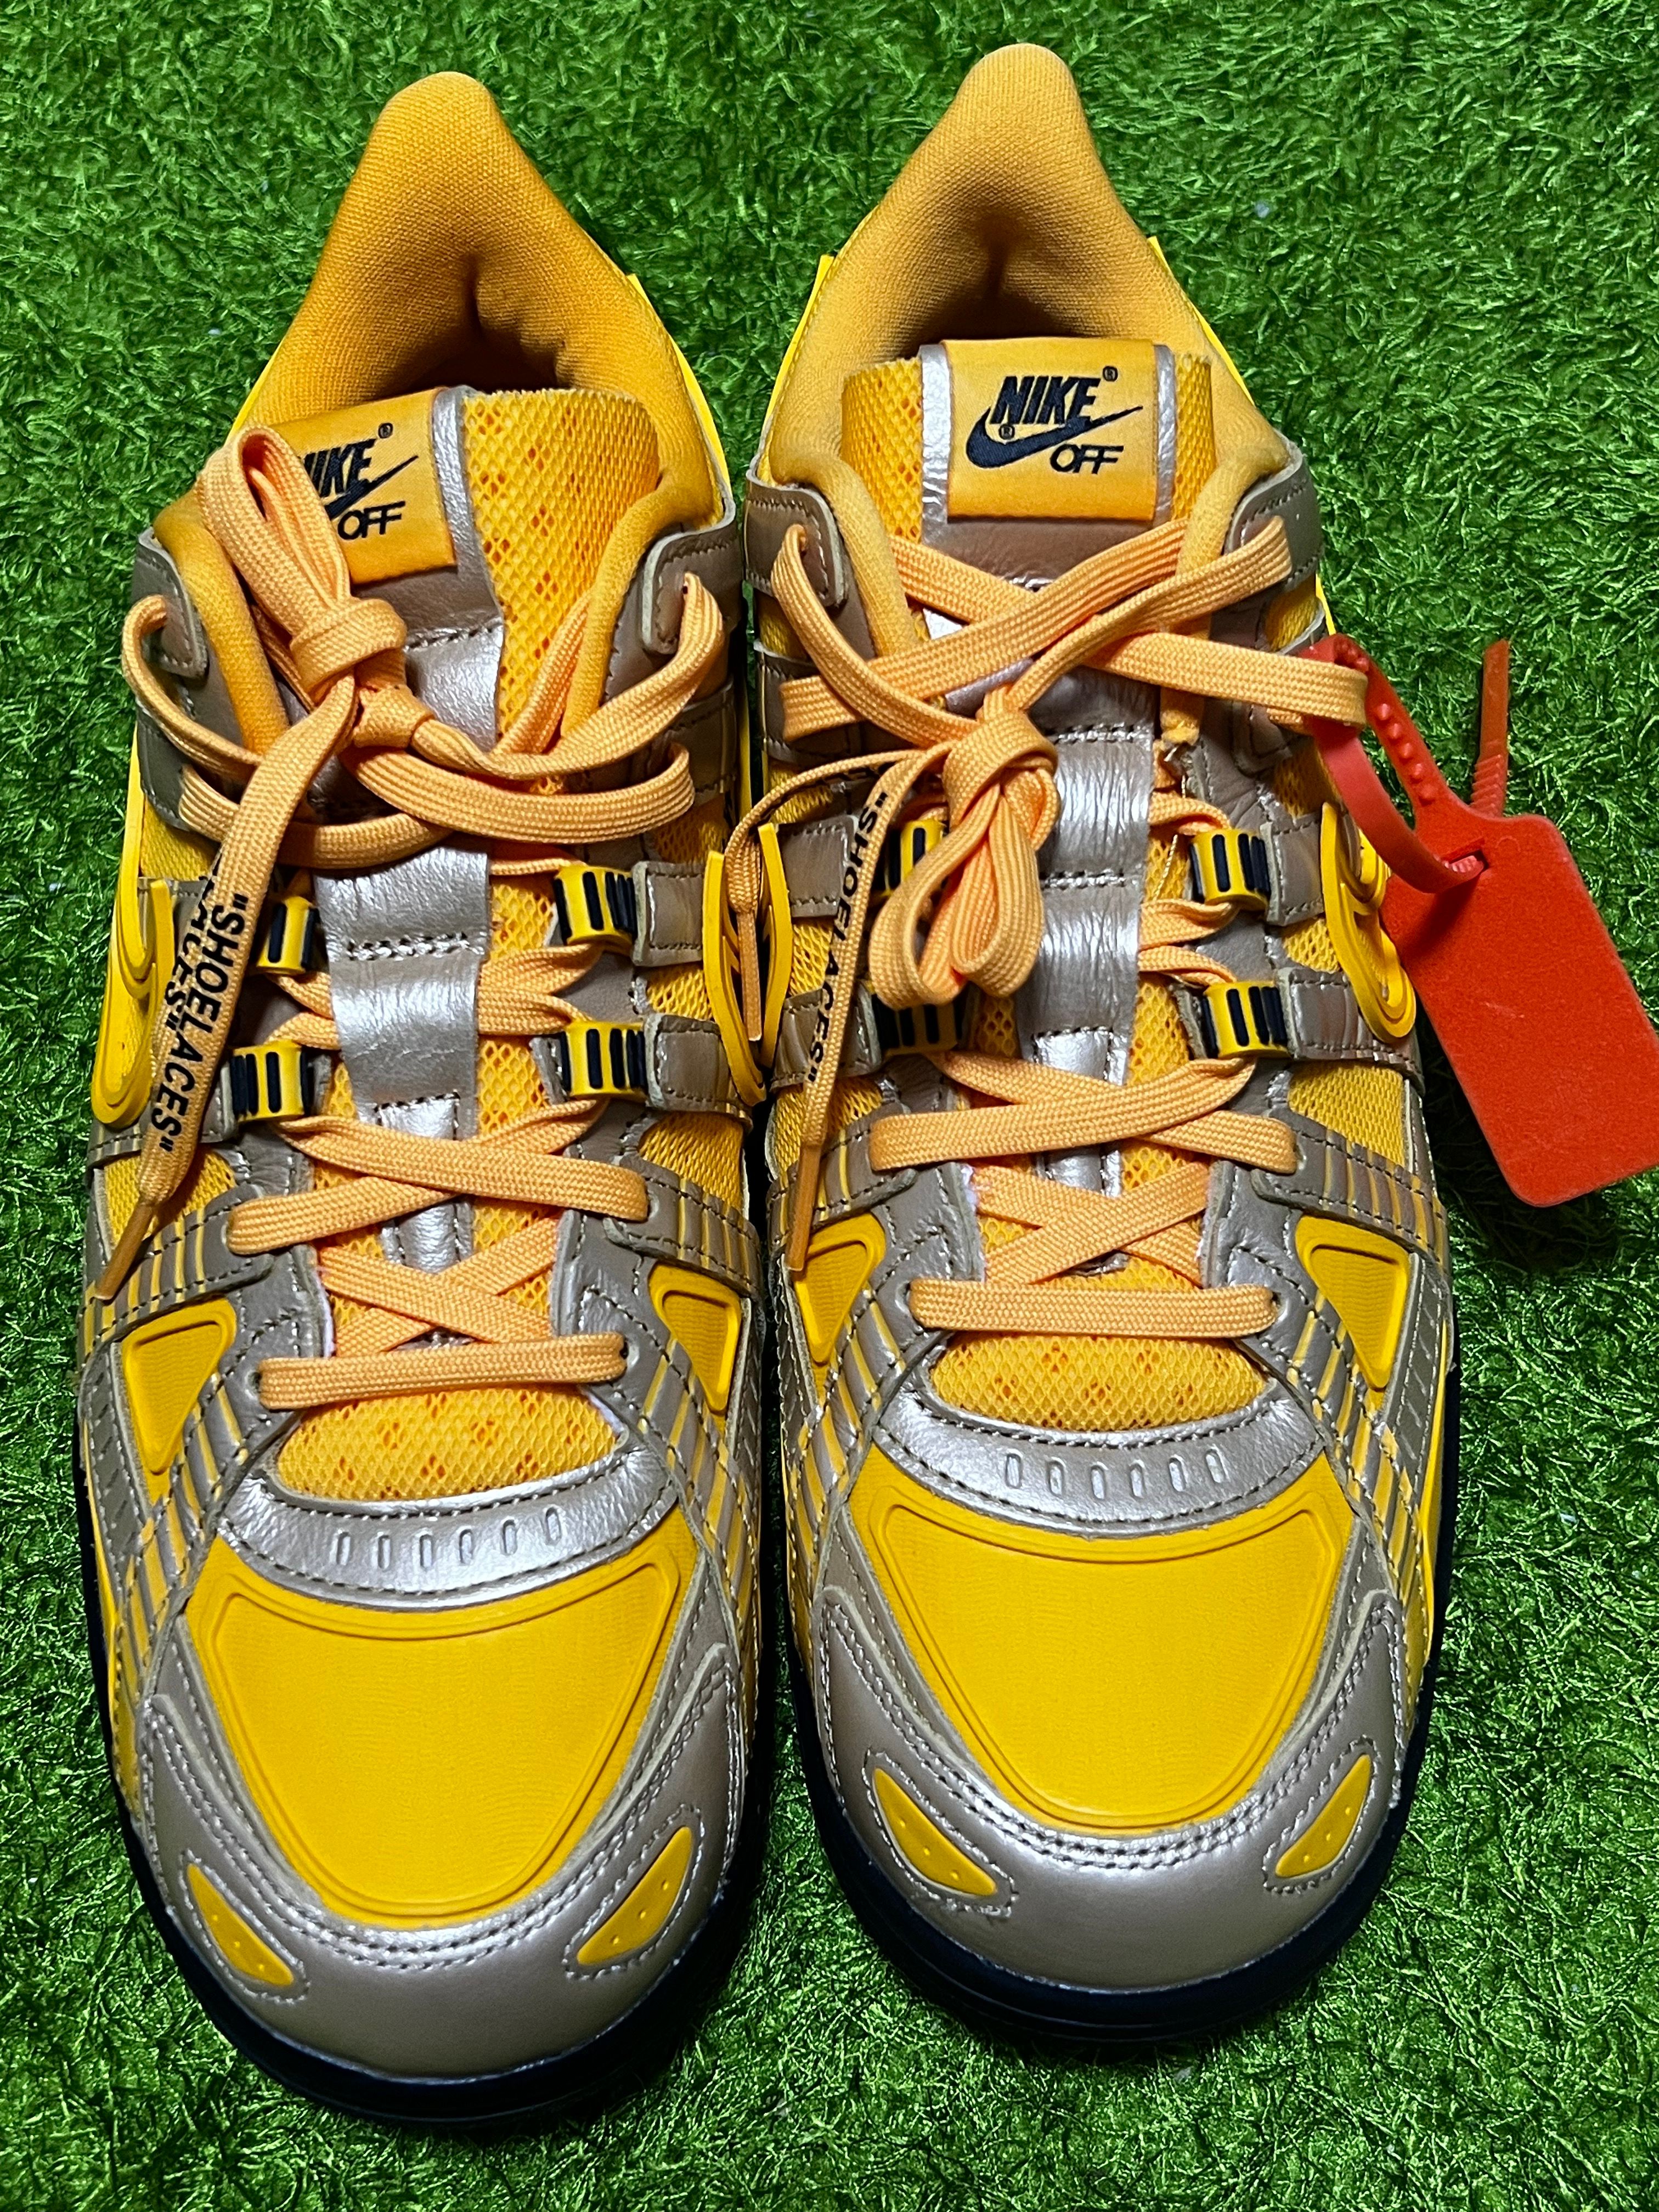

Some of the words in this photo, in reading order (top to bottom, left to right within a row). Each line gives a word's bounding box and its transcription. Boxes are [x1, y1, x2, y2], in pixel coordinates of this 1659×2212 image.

[990, 376, 1101, 425] NIKE
[304, 438, 377, 497] IKE
[1050, 444, 1124, 475] OFF
[337, 501, 406, 540] OFF
[151, 893, 249, 1153] "SHOELACES"
